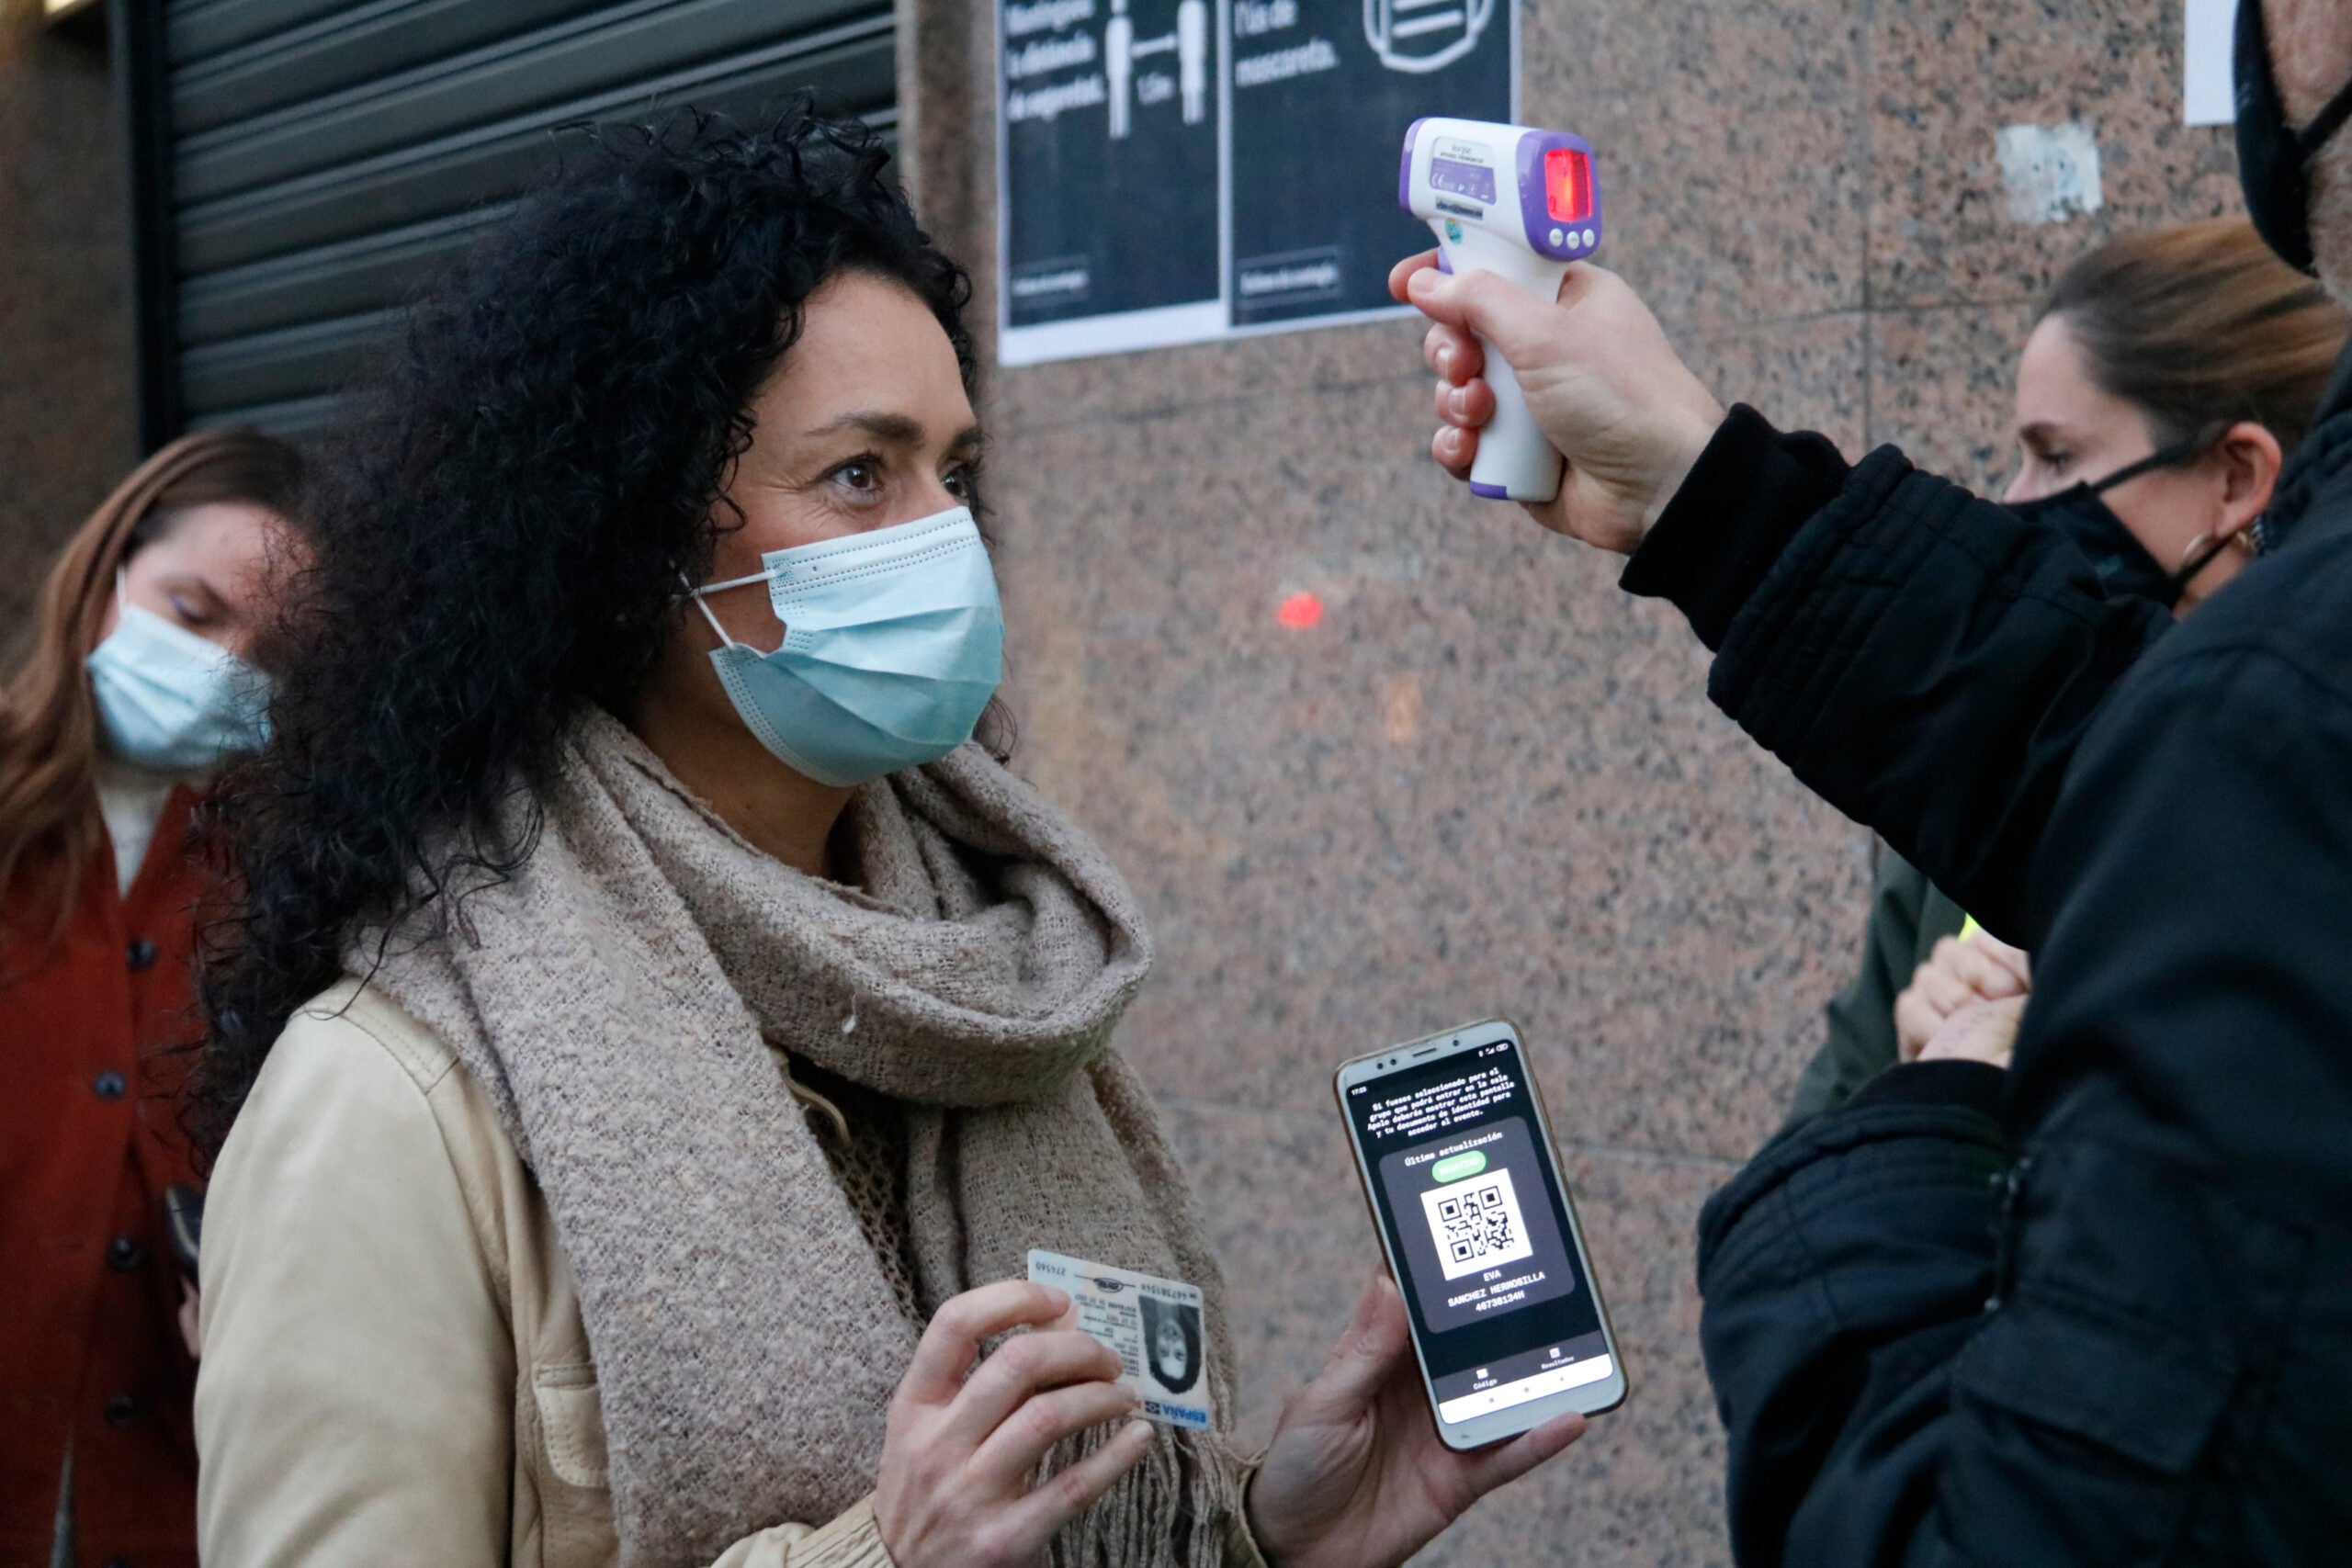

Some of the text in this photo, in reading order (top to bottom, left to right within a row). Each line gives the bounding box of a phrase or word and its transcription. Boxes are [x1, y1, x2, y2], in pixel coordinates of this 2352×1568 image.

[1367, 1081, 1516, 1131] Apolo deberás mostrar esta pantalla
[1369, 1074, 1509, 1122] grupo que podrá entrar en la sala
[1373, 1067, 1500, 1111] Si fueses seleccionado para el
[1376, 1091, 1511, 1138] y tu documento de identidad para
[1408, 1111, 1485, 1137] acceder al evento.
[1405, 1132, 1503, 1167] Última actualización
[1447, 1270, 1546, 1307] SANCHEZ HERMOSILLA
[1483, 1269, 1502, 1282] EVA
[1473, 1378, 1498, 1390] Código
[1162, 1404, 1207, 1424] ESPAÑA
